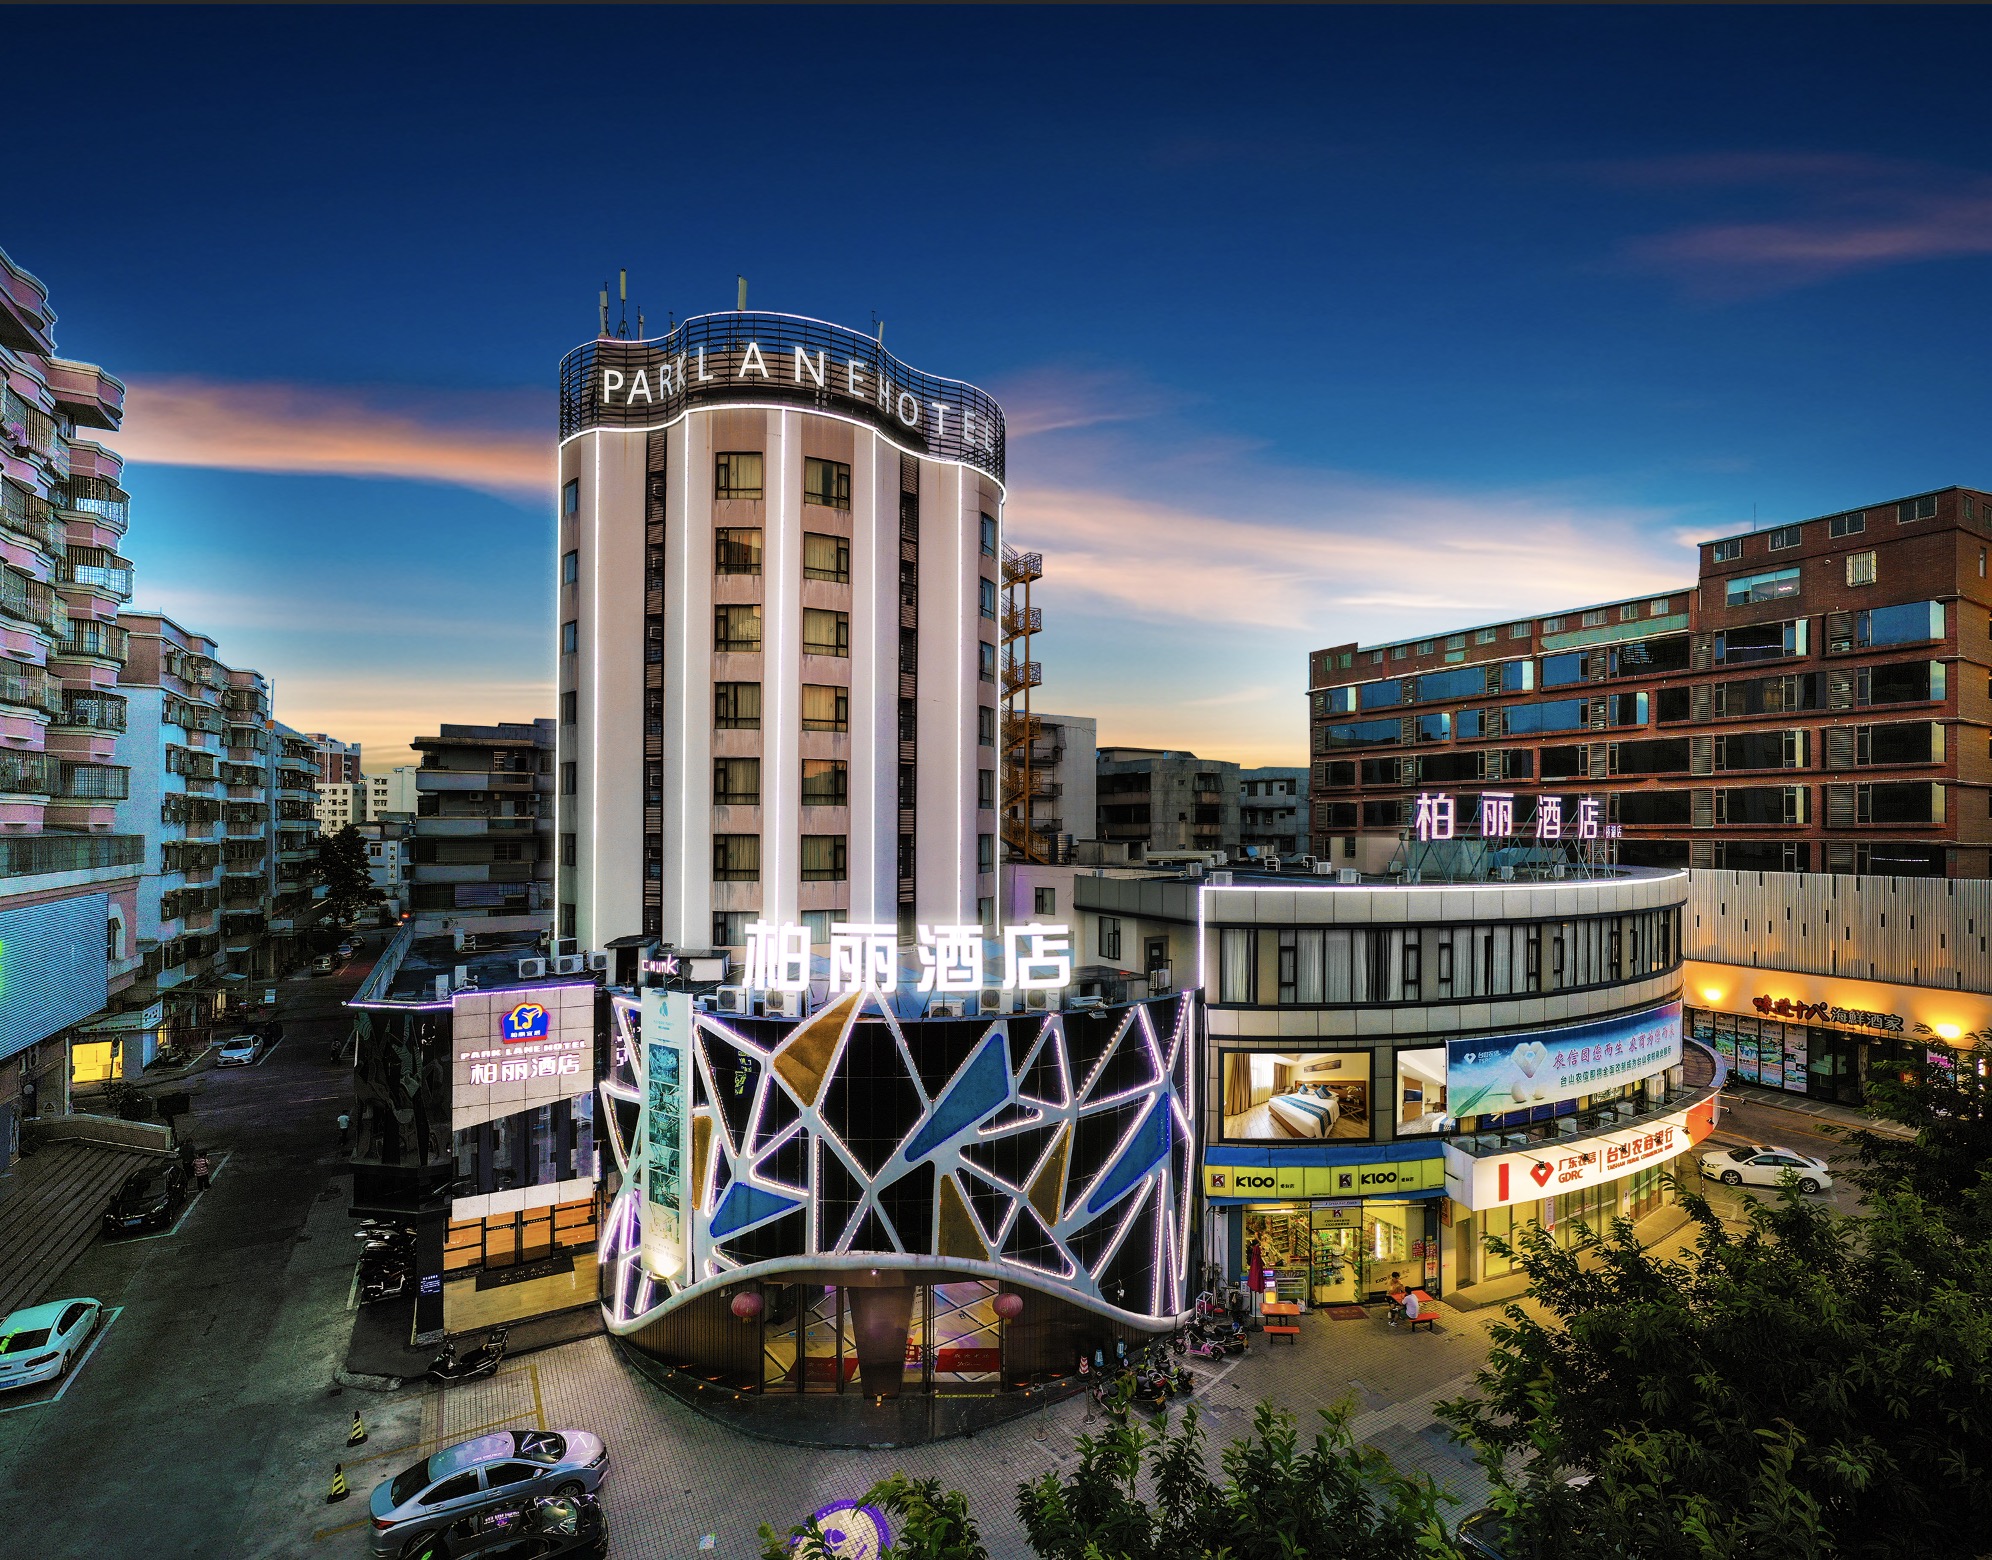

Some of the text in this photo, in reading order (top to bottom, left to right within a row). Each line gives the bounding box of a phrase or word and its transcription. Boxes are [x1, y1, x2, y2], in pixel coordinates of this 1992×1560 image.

[603, 342, 994, 454] PARK LANE HOTEL
[1416, 791, 1600, 842] 柏丽酒店
[742, 918, 1071, 993] 柏丽酒店
[460, 1040, 587, 1060] PARK LANE HOTEL
[470, 1053, 580, 1085] 柏丽酒店
[1236, 1176, 1275, 1189] K100
[1361, 1171, 1397, 1185] K100
[1558, 1168, 1584, 1183] GDRC
